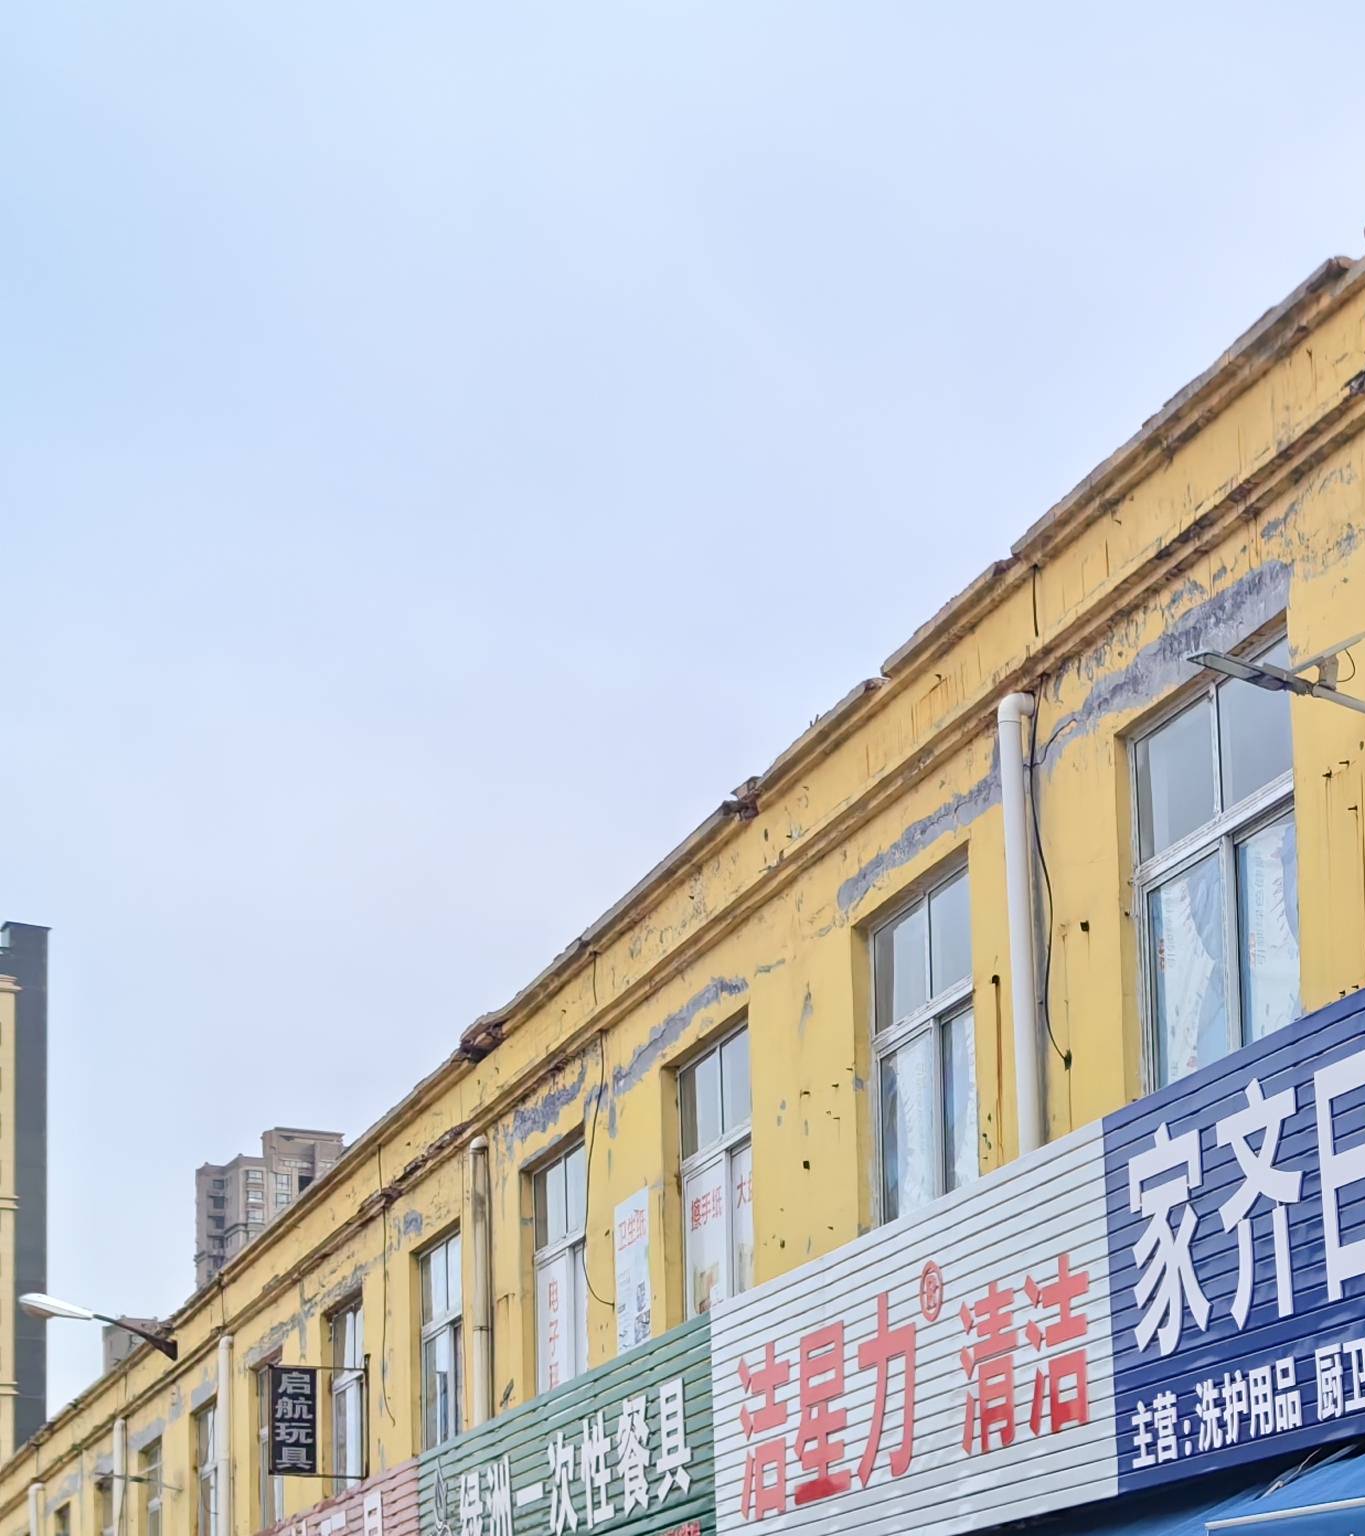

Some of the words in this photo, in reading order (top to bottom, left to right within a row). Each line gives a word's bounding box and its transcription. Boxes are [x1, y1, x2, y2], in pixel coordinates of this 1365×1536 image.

[275, 1373, 314, 1473] 启航玩具
[738, 1291, 916, 1521] 洁星力
[960, 1253, 1090, 1456] 清洁
